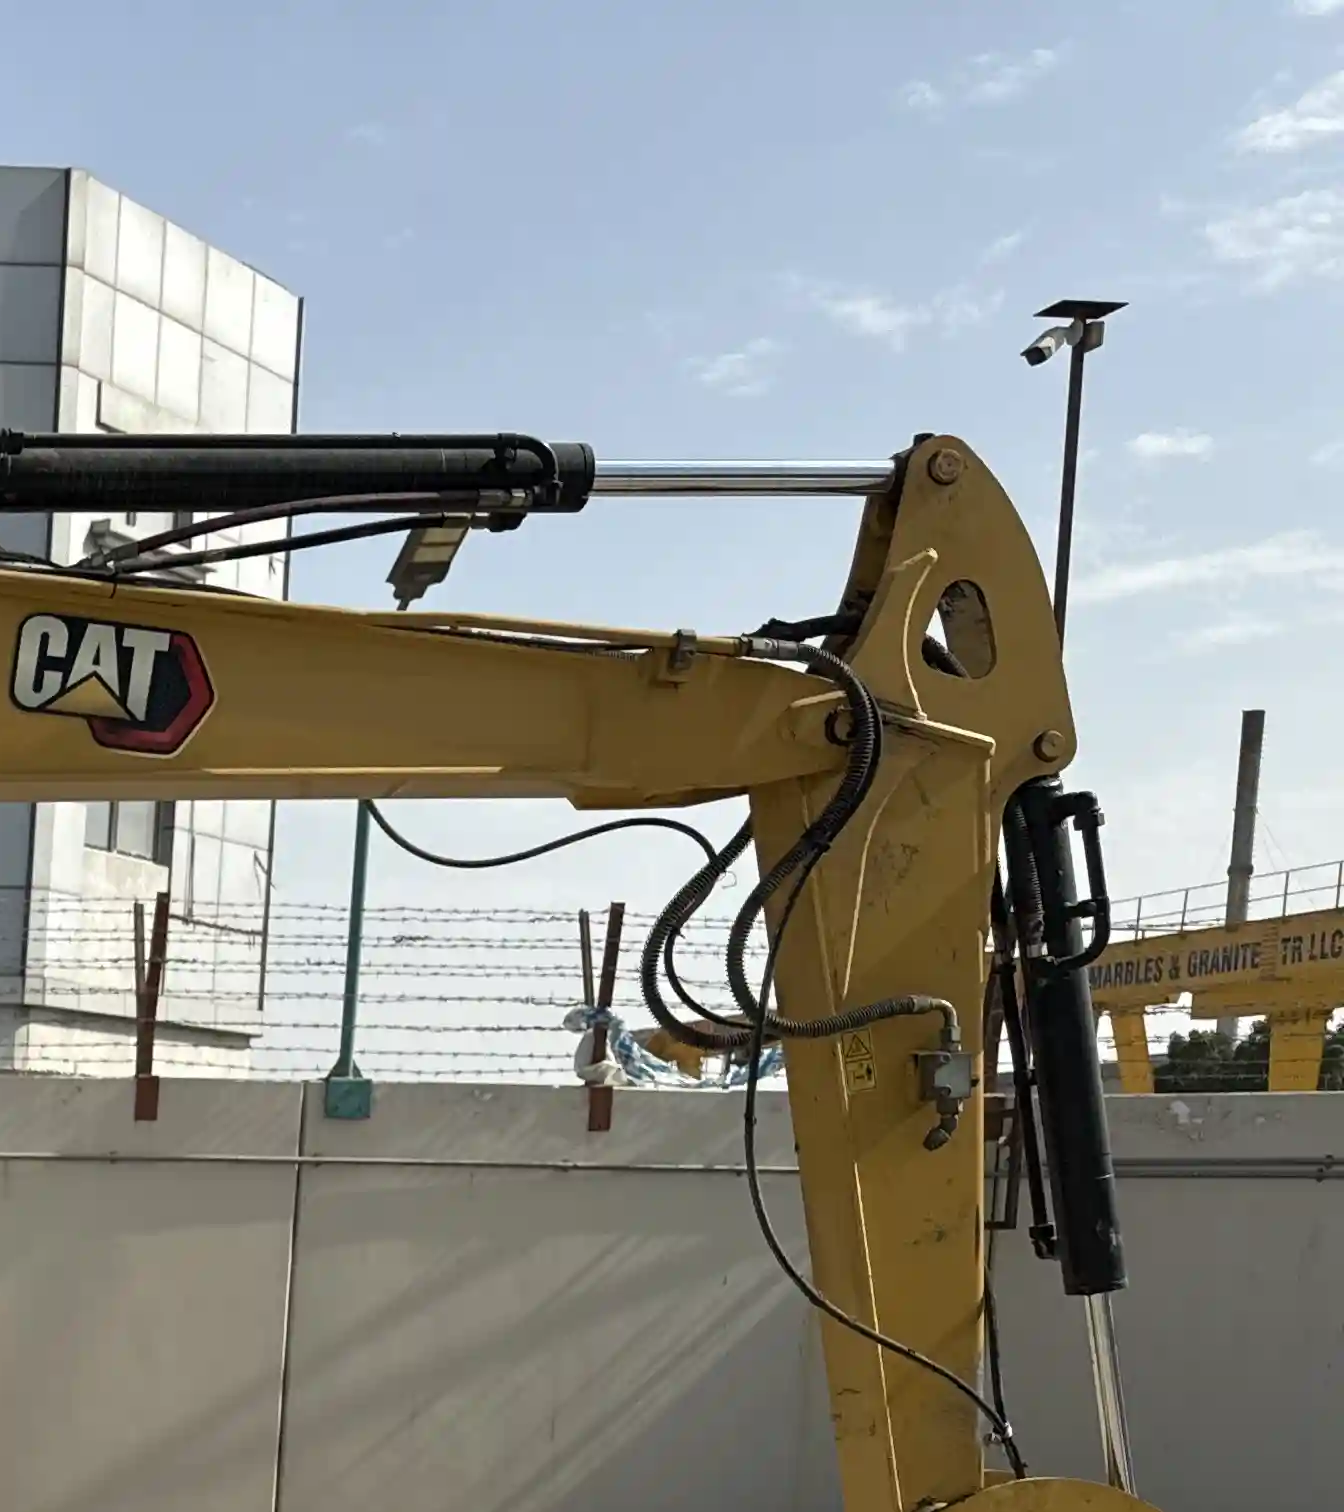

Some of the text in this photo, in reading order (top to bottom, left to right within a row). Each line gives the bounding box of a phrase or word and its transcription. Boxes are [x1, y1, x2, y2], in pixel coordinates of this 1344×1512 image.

[14, 614, 171, 722] CAT
[1089, 928, 1344, 991] MARBLES & GRANITE TR LLC
